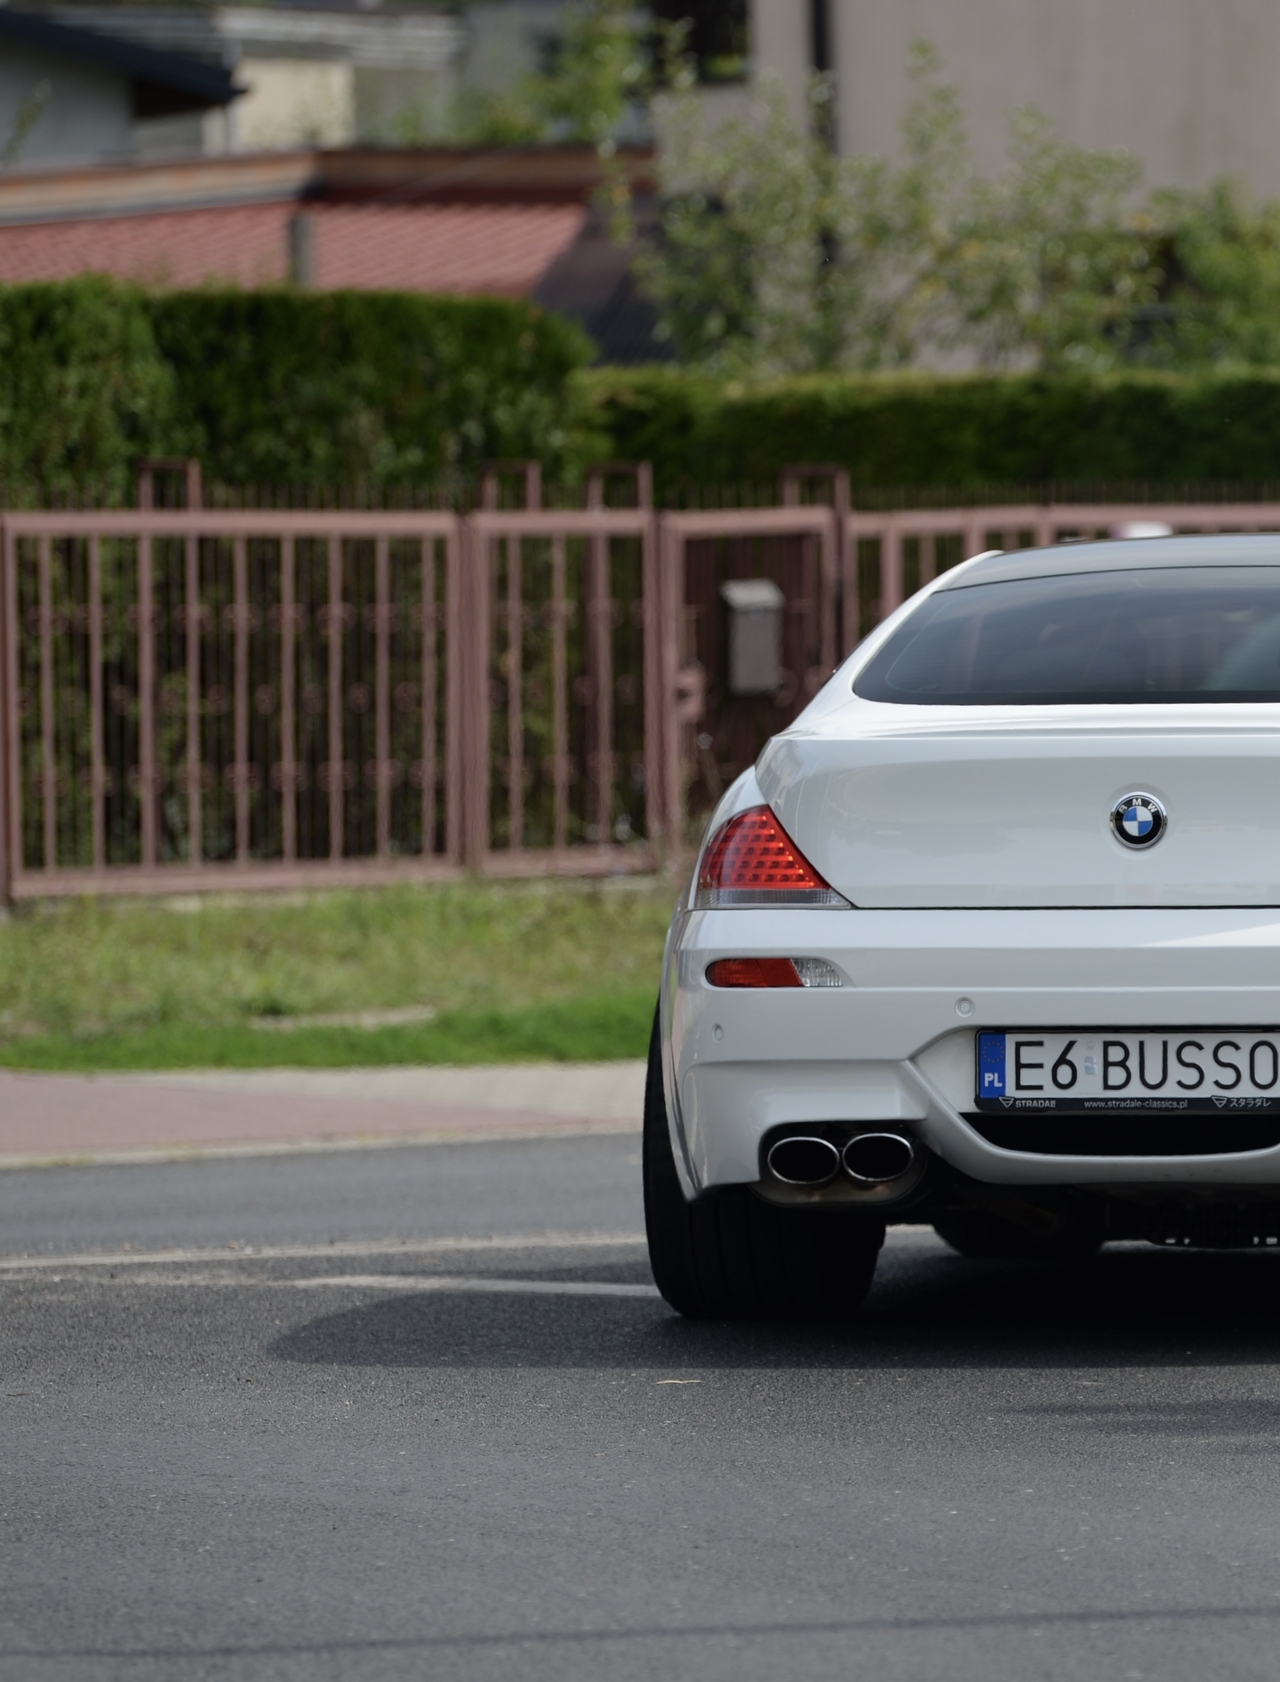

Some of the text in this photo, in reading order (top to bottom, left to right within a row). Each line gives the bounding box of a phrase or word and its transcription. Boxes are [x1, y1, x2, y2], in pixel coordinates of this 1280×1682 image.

[1118, 797, 1158, 814] BMW
[1014, 1040, 1078, 1091] E6
[984, 1072, 1003, 1087] PL
[1084, 1099, 1188, 1110] www.stradale-classics.pl
